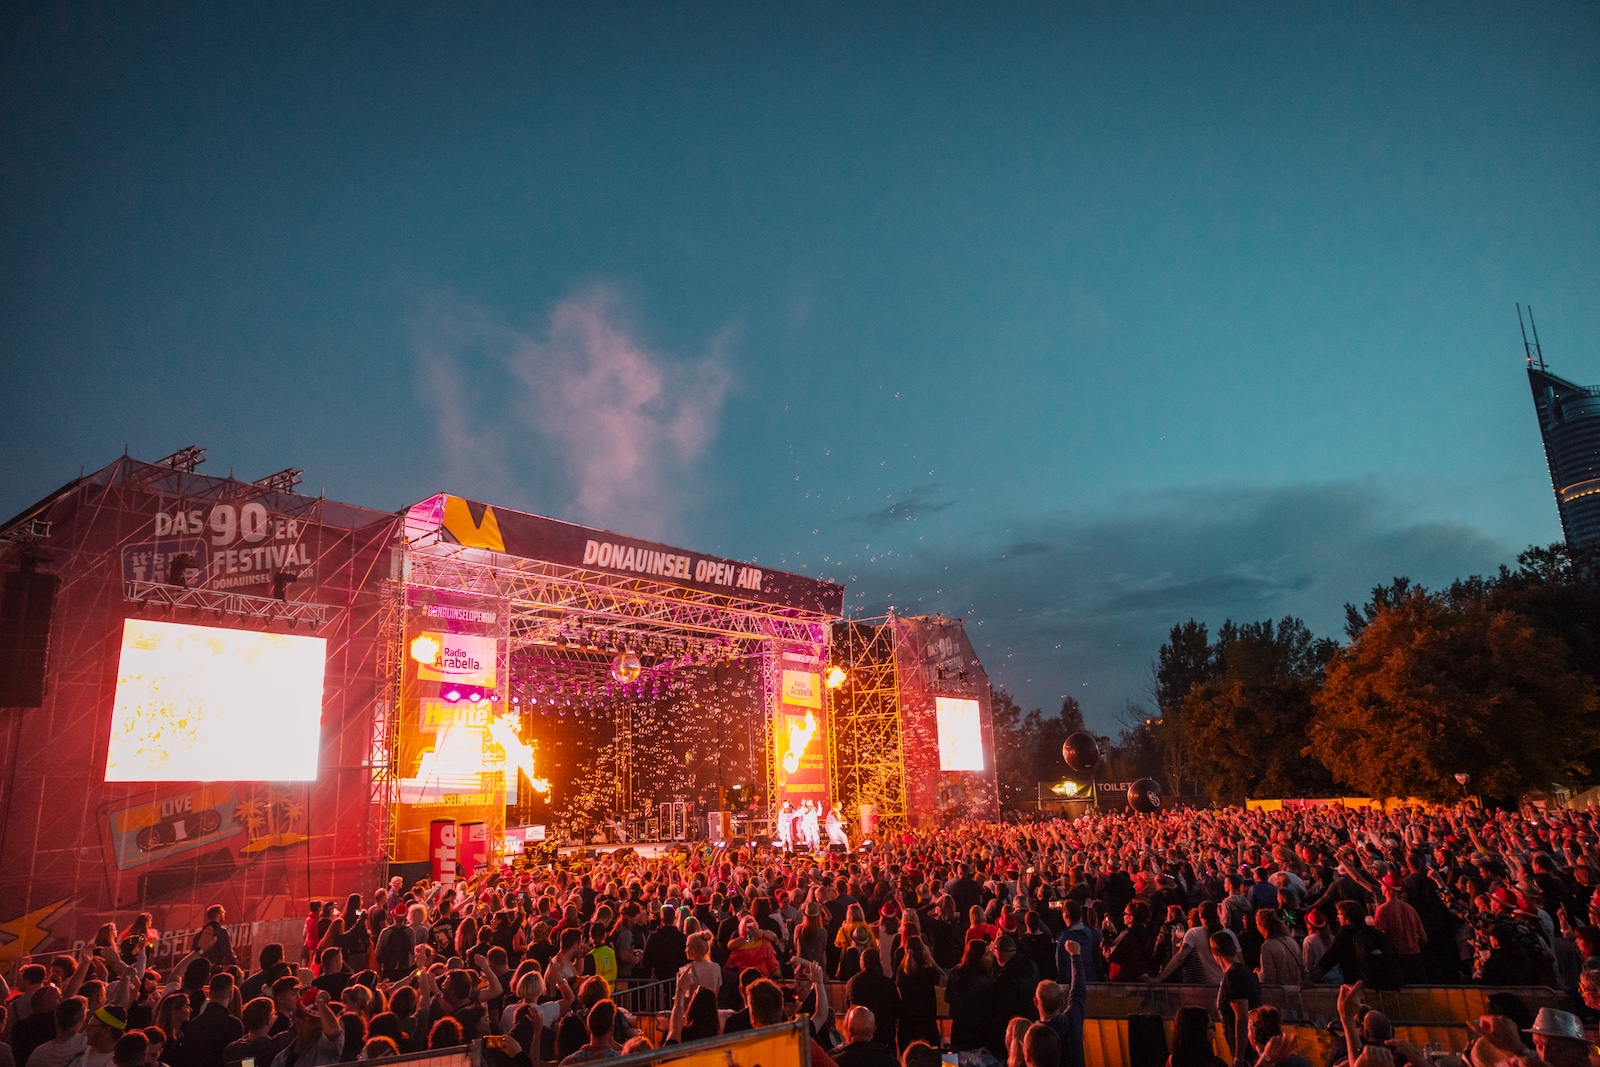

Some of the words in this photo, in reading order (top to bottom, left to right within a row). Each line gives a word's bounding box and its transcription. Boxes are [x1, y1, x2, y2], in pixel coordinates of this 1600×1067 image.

[155, 509, 204, 537] DAS
[213, 543, 312, 575] FESTIVAL
[583, 539, 692, 580] DONAUINSEL
[695, 559, 735, 587] OPEN
[736, 567, 763, 591] AIR
[212, 573, 271, 590] DONAUINSEL
[444, 647, 467, 658] Radio
[161, 797, 192, 818] LIVE
